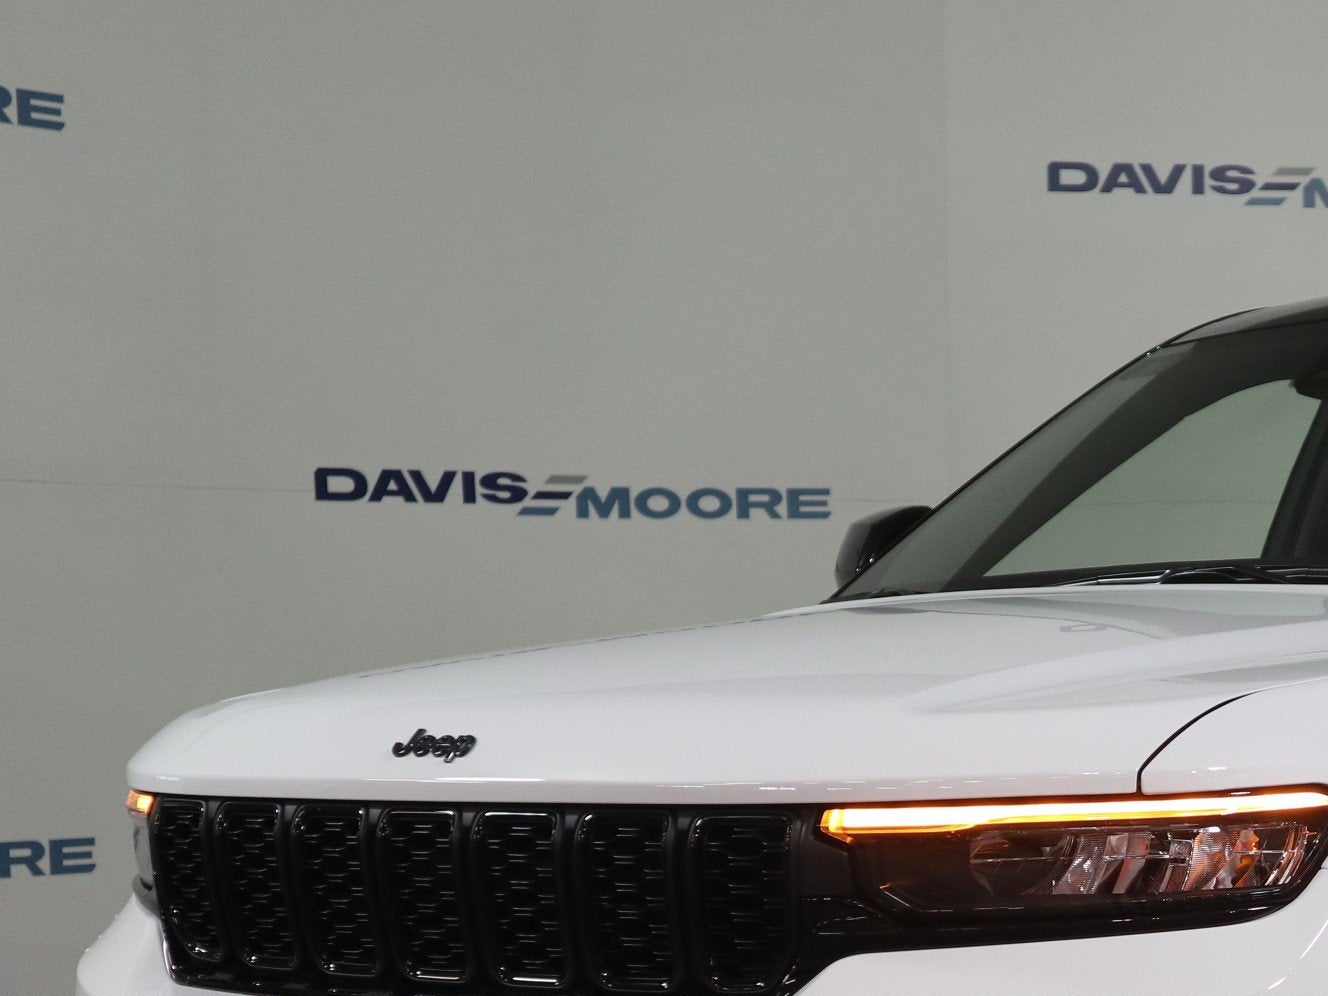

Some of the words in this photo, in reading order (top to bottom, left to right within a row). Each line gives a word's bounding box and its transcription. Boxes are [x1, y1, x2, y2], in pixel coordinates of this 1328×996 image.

[1047, 161, 1256, 195] DAVIS
[314, 467, 529, 505] DAVIS
[576, 486, 831, 519] MOORE
[391, 728, 477, 763] Jeep
